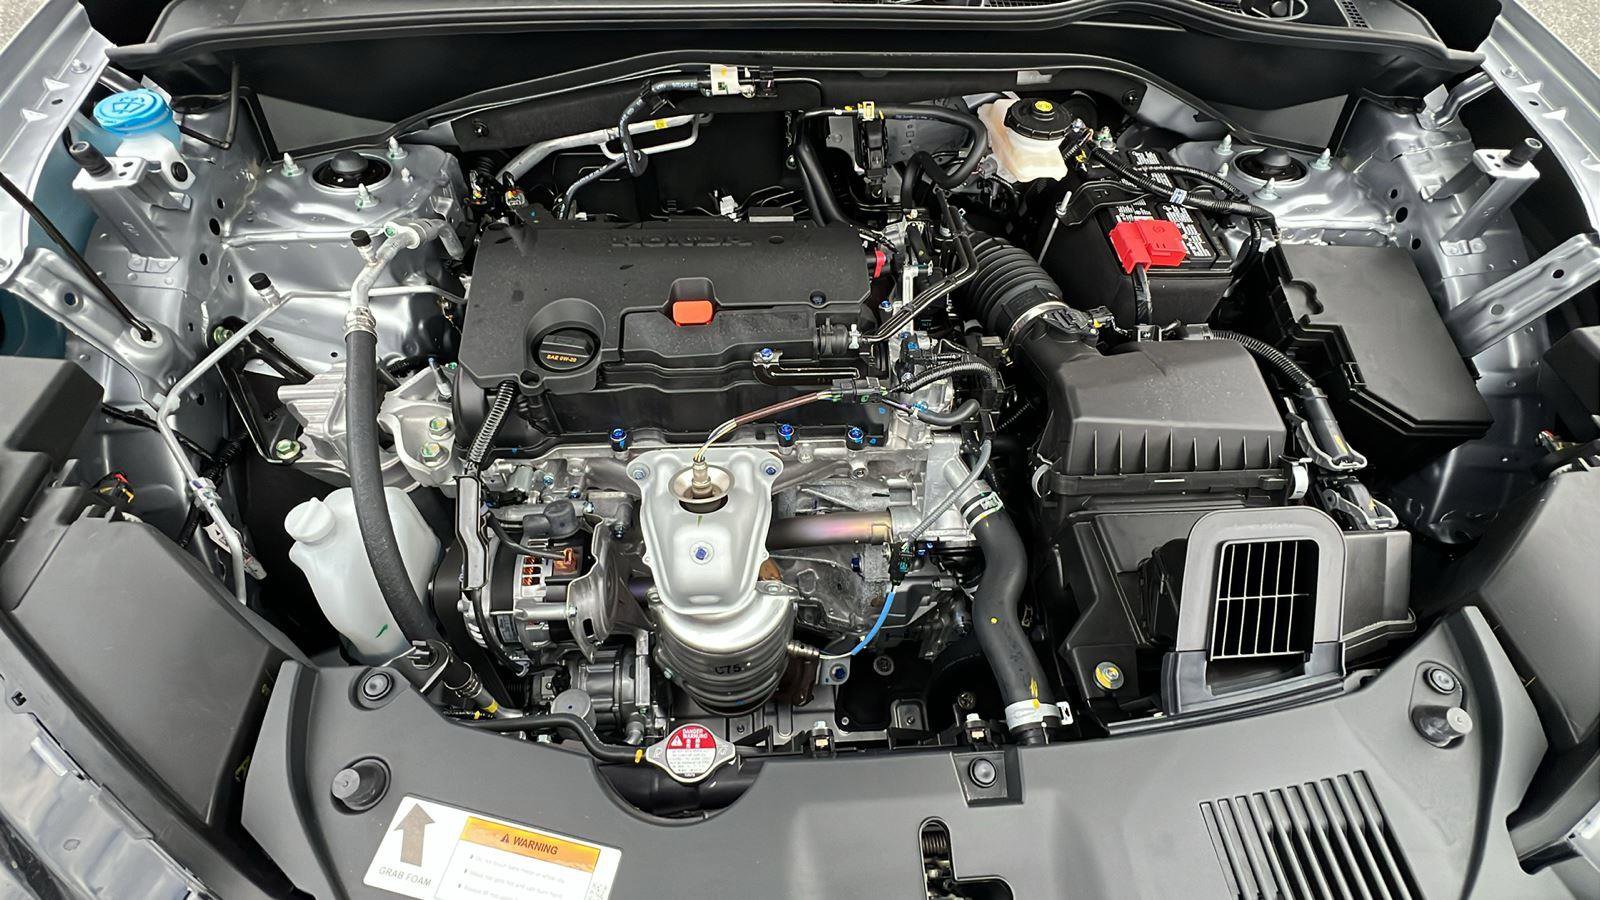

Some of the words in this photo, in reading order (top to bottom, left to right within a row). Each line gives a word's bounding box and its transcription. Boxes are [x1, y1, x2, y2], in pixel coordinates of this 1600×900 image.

[560, 355, 577, 363] 0W-20
[513, 835, 559, 856] WARNING
[378, 866, 405, 880] GRAB
[406, 872, 432, 887] FOAM
